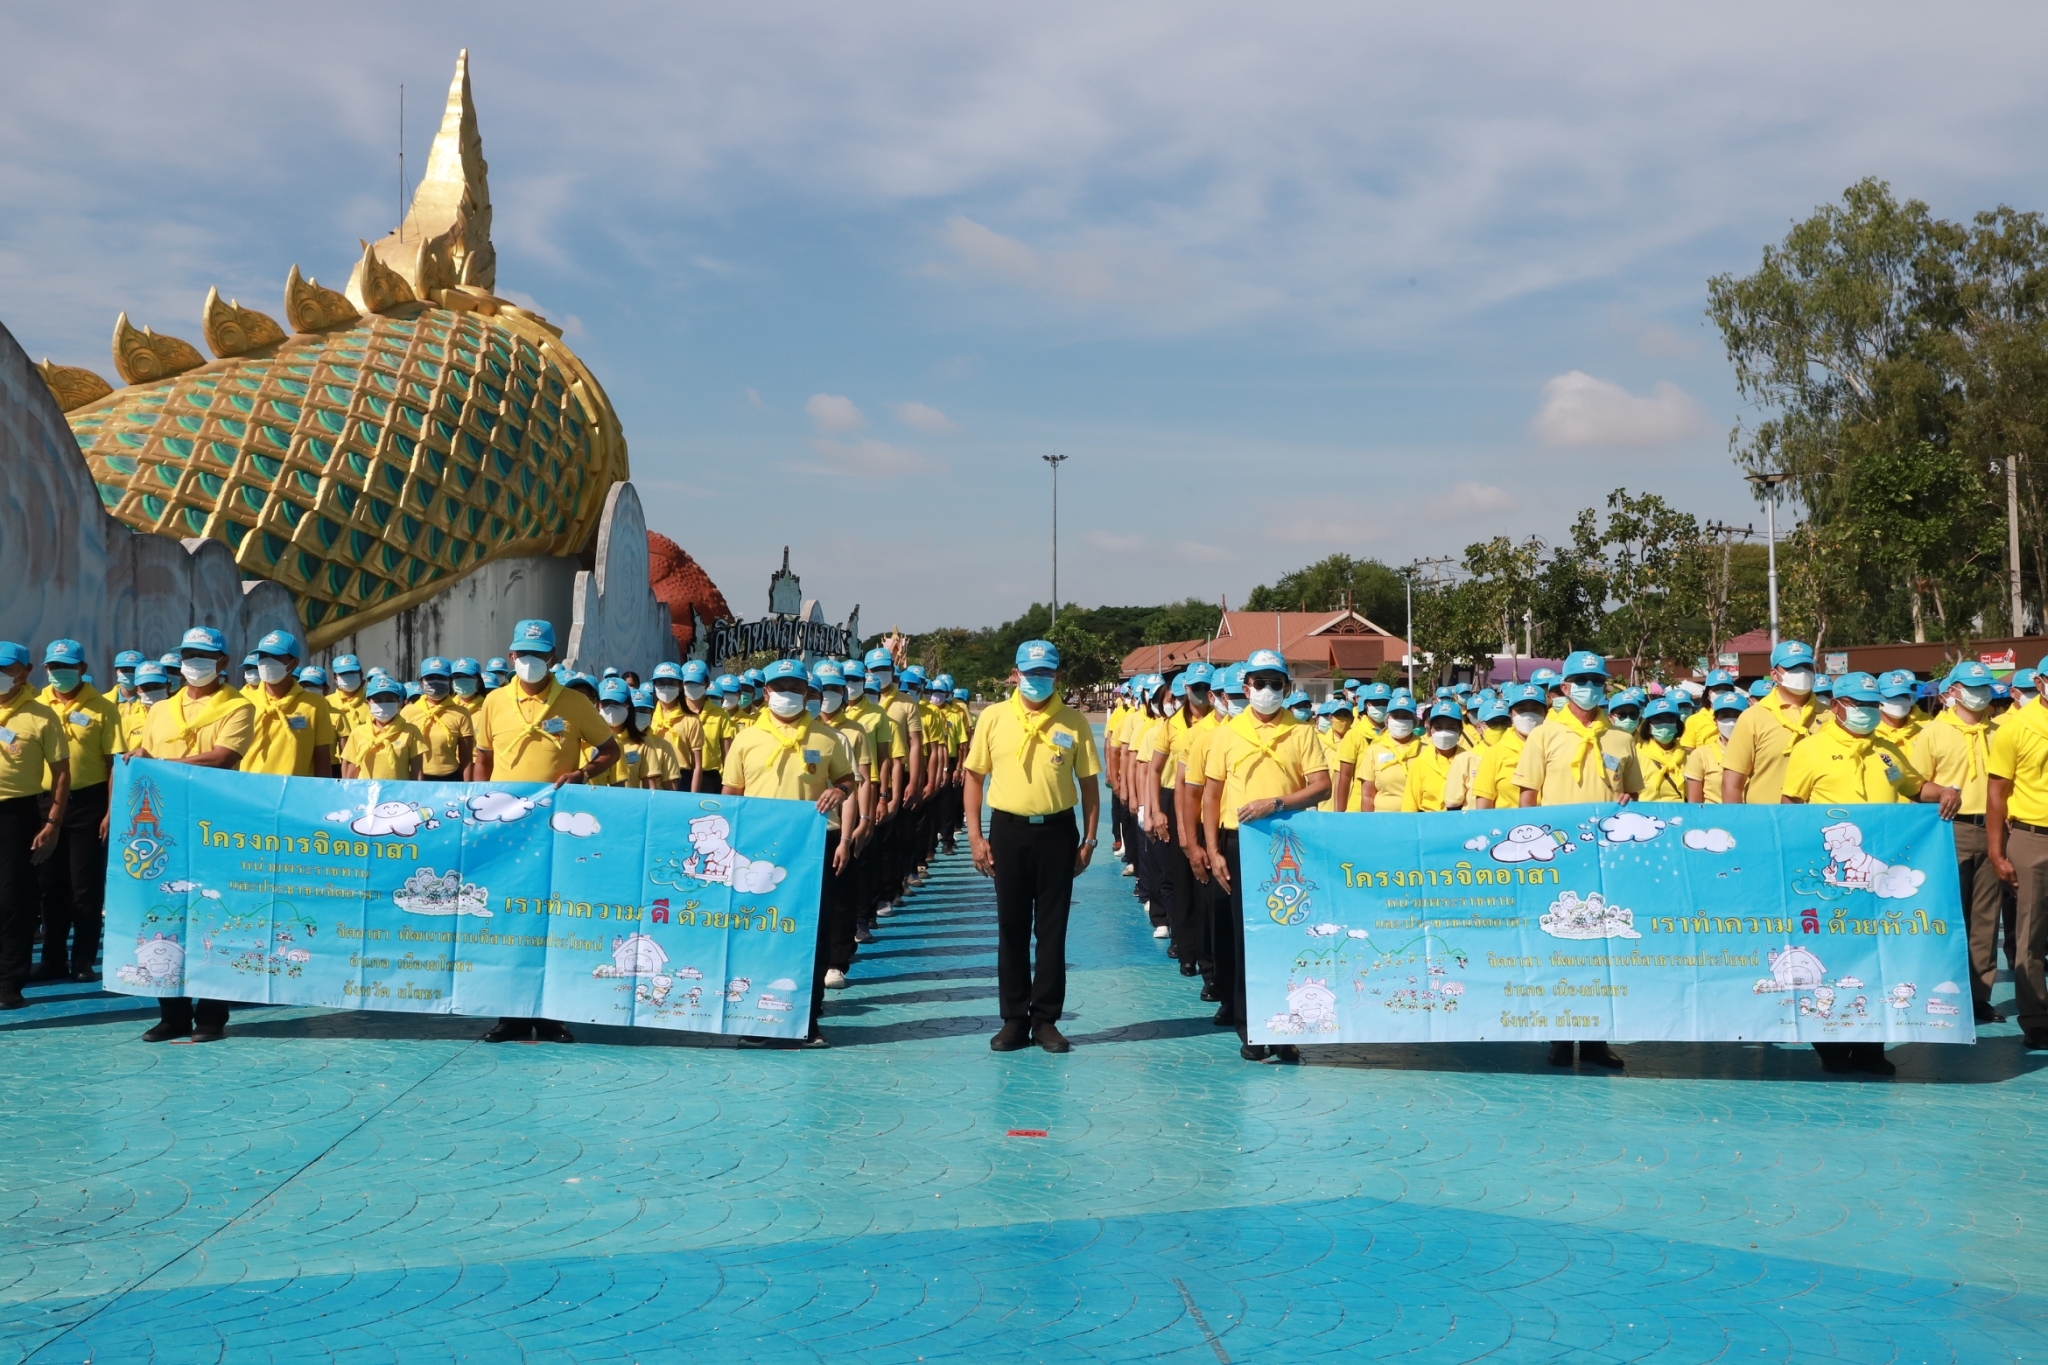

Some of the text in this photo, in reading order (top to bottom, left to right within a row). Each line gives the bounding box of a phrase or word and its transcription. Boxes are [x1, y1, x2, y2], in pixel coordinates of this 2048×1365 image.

[198, 820, 419, 860] โครงการจิตอาสา
[240, 859, 370, 879] หน่วยพระราชทาน
[1340, 861, 1560, 889] โครงการจิตอาสา
[228, 881, 382, 901] และประชาชนจิตอาสา
[1385, 892, 1515, 908] หน่วยพระราชทาน
[504, 893, 796, 934] เราทำความ ดี ด้วยหัวใจ
[1375, 915, 1529, 931] และประชาชนจิตอาสา
[1652, 908, 1947, 936] เราทำความ ดี ด้วยหัวใจ
[336, 922, 390, 941] จิตอาสา
[349, 952, 473, 972] อำเภอ เมืองยโสธร
[1487, 951, 1542, 968] จิตอาสา
[343, 981, 442, 1000] จังหวัด ยโสธร
[1504, 978, 1629, 998] อำเภอ เมืองยโสธร
[1501, 1009, 1600, 1028] จังหวัด ยโสธร
